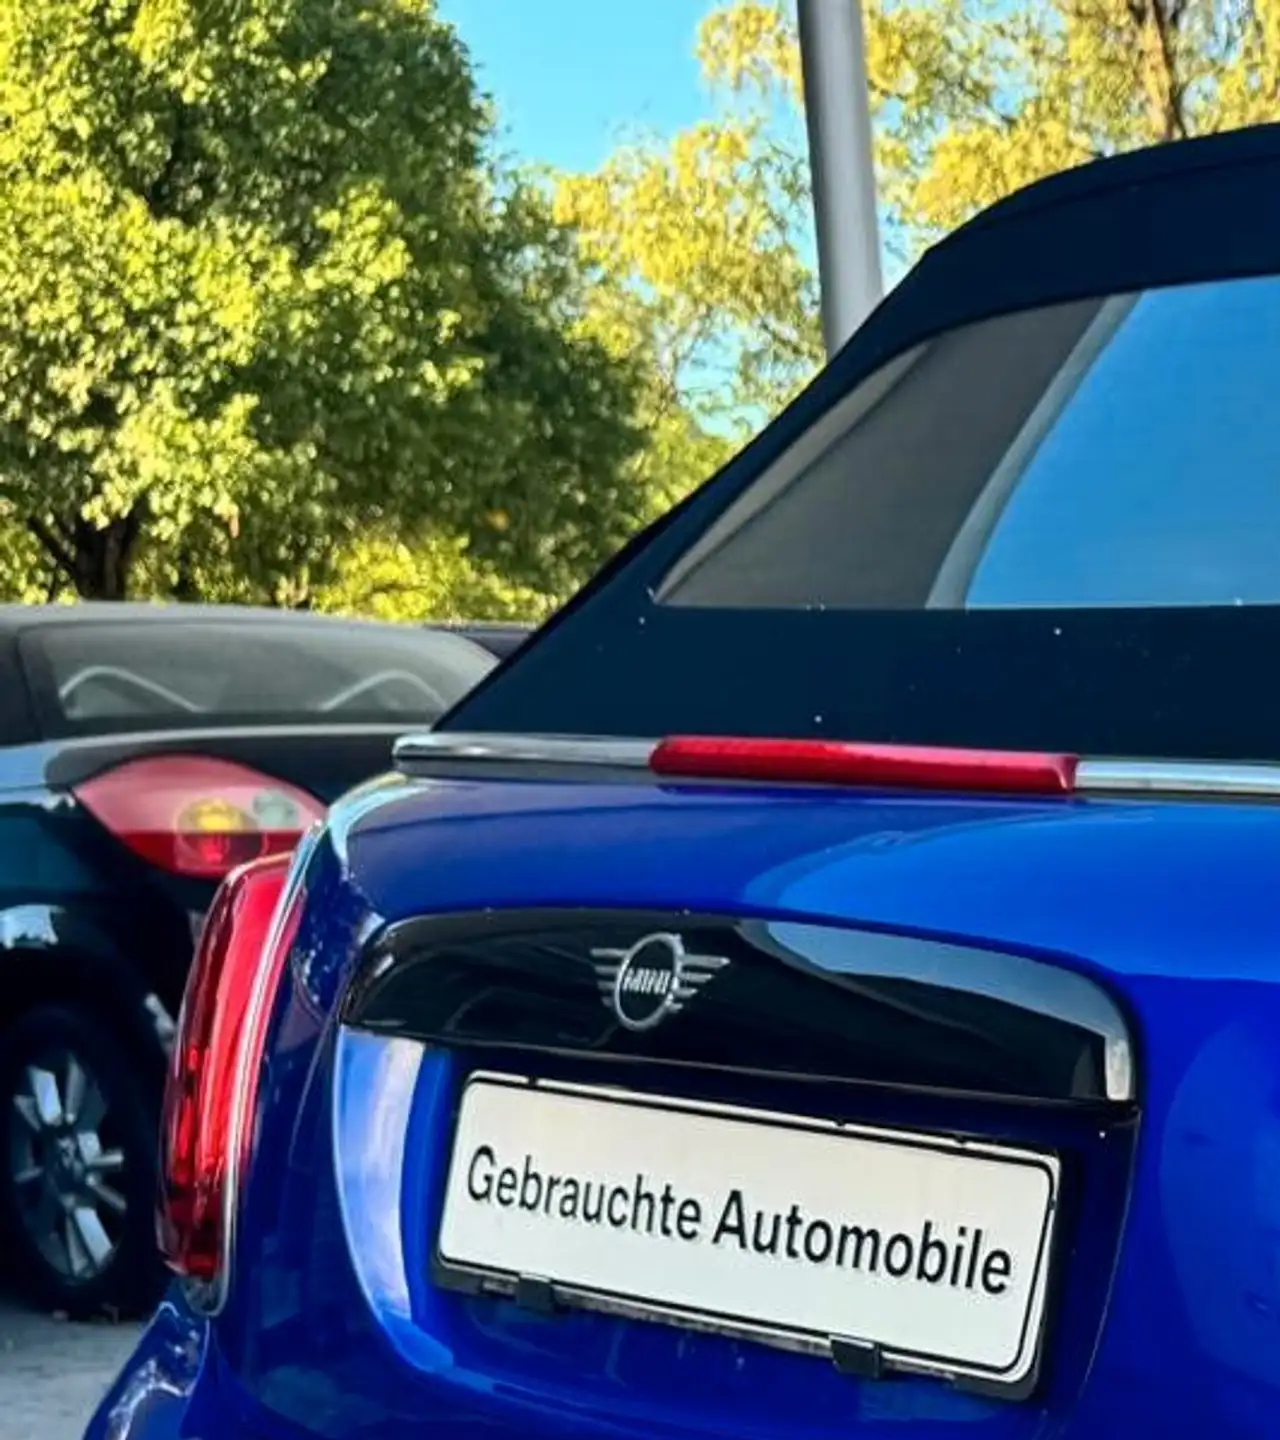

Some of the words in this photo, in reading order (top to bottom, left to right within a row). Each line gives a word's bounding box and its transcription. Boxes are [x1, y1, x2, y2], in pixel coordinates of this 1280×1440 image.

[622, 966, 671, 995] MINI
[467, 1145, 701, 1241] Gebrauchte
[712, 1189, 1012, 1295] Automobile
